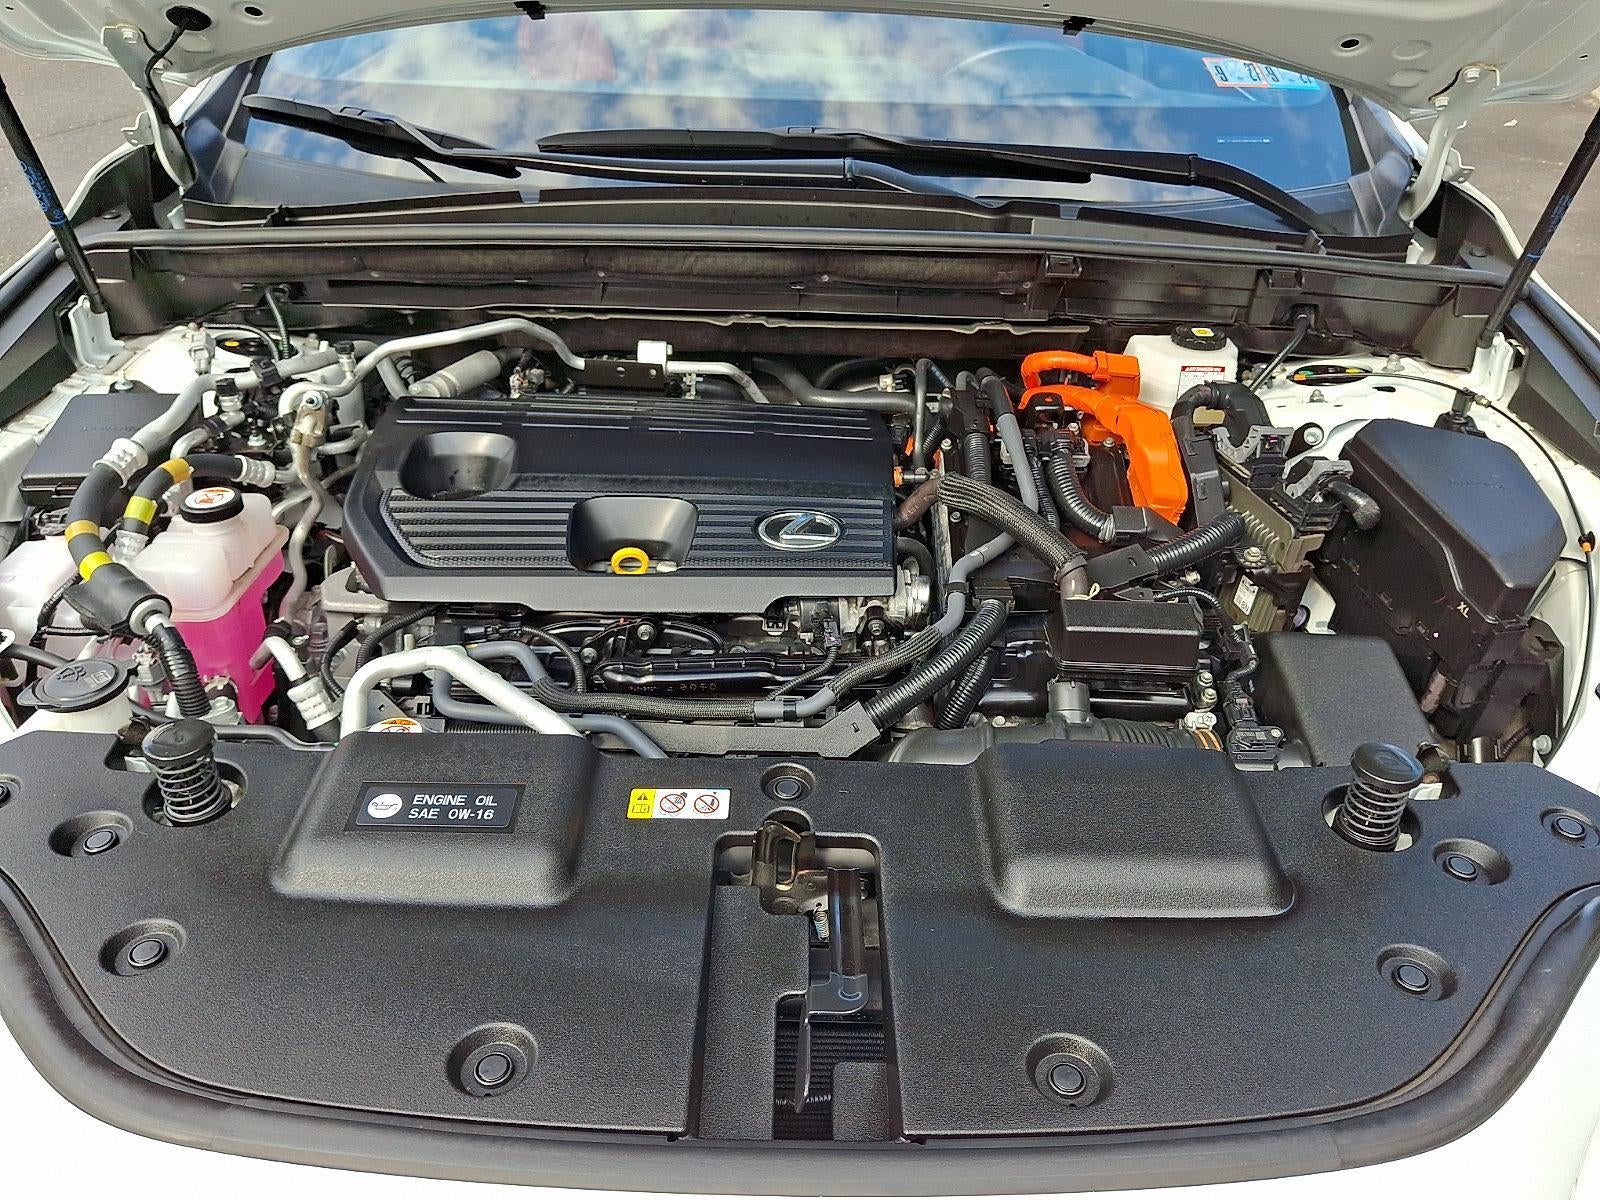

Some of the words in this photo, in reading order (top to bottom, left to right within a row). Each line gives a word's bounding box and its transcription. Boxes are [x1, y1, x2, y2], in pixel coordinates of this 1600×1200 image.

[412, 794, 468, 806] ENGINE
[474, 794, 498, 806] OIL
[408, 807, 440, 820] SAE
[447, 807, 495, 820] 0W-16
